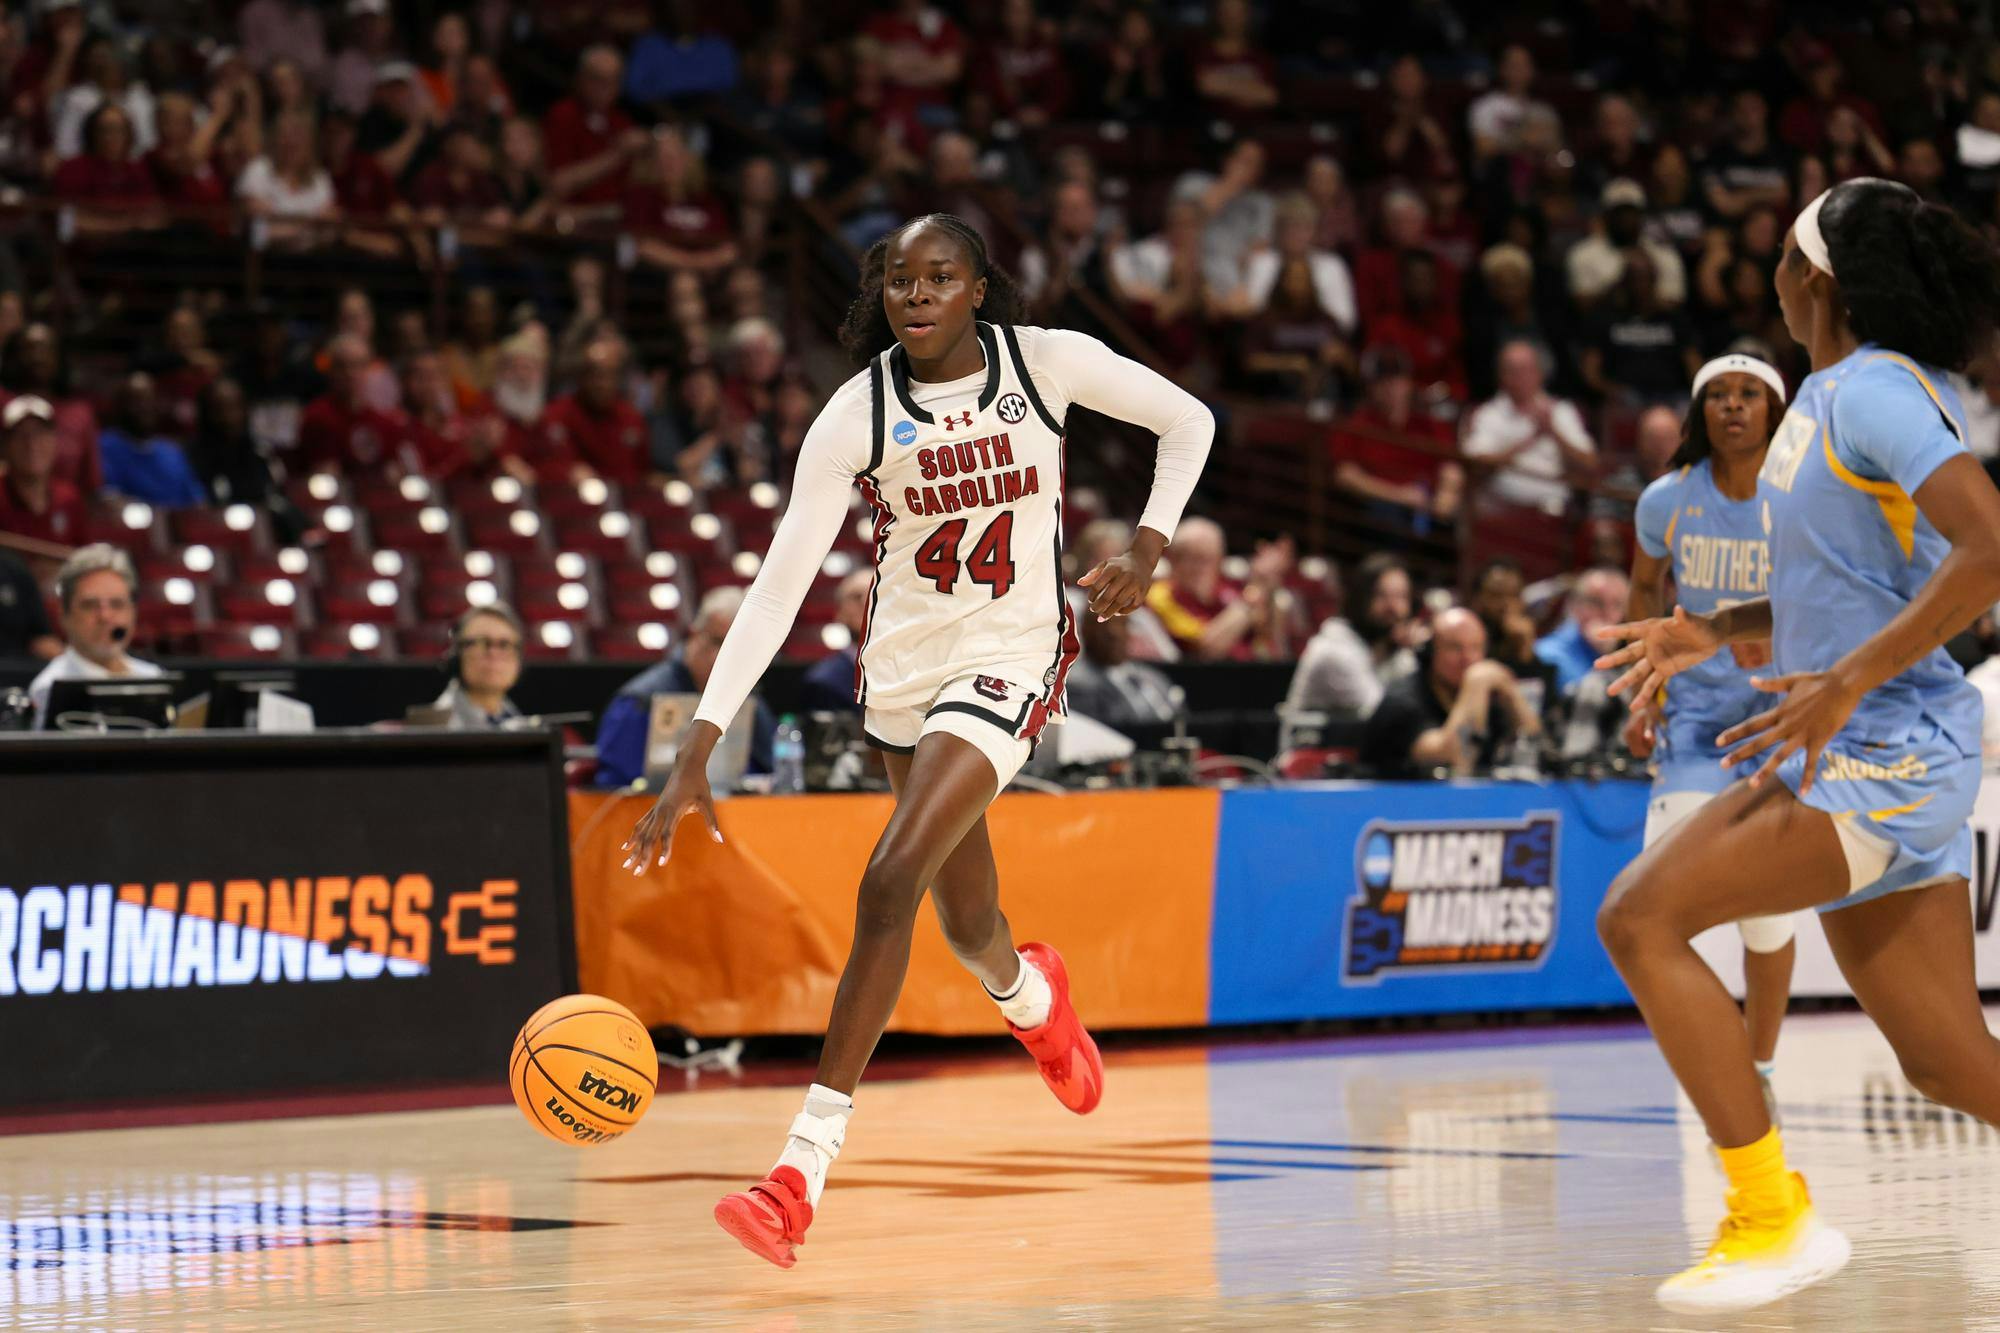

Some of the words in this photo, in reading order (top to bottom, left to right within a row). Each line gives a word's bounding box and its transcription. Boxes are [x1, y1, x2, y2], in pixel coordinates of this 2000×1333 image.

[998, 395, 1027, 422] SEC
[917, 433, 1015, 481] SOUTH
[904, 465, 1040, 517] CAROLINA
[915, 510, 1016, 601] 44
[1391, 830, 1505, 892] MARCH
[1402, 887, 1554, 947] MADNESS
[578, 1070, 643, 1115] NCAA
[545, 1096, 624, 1144] Wilson
